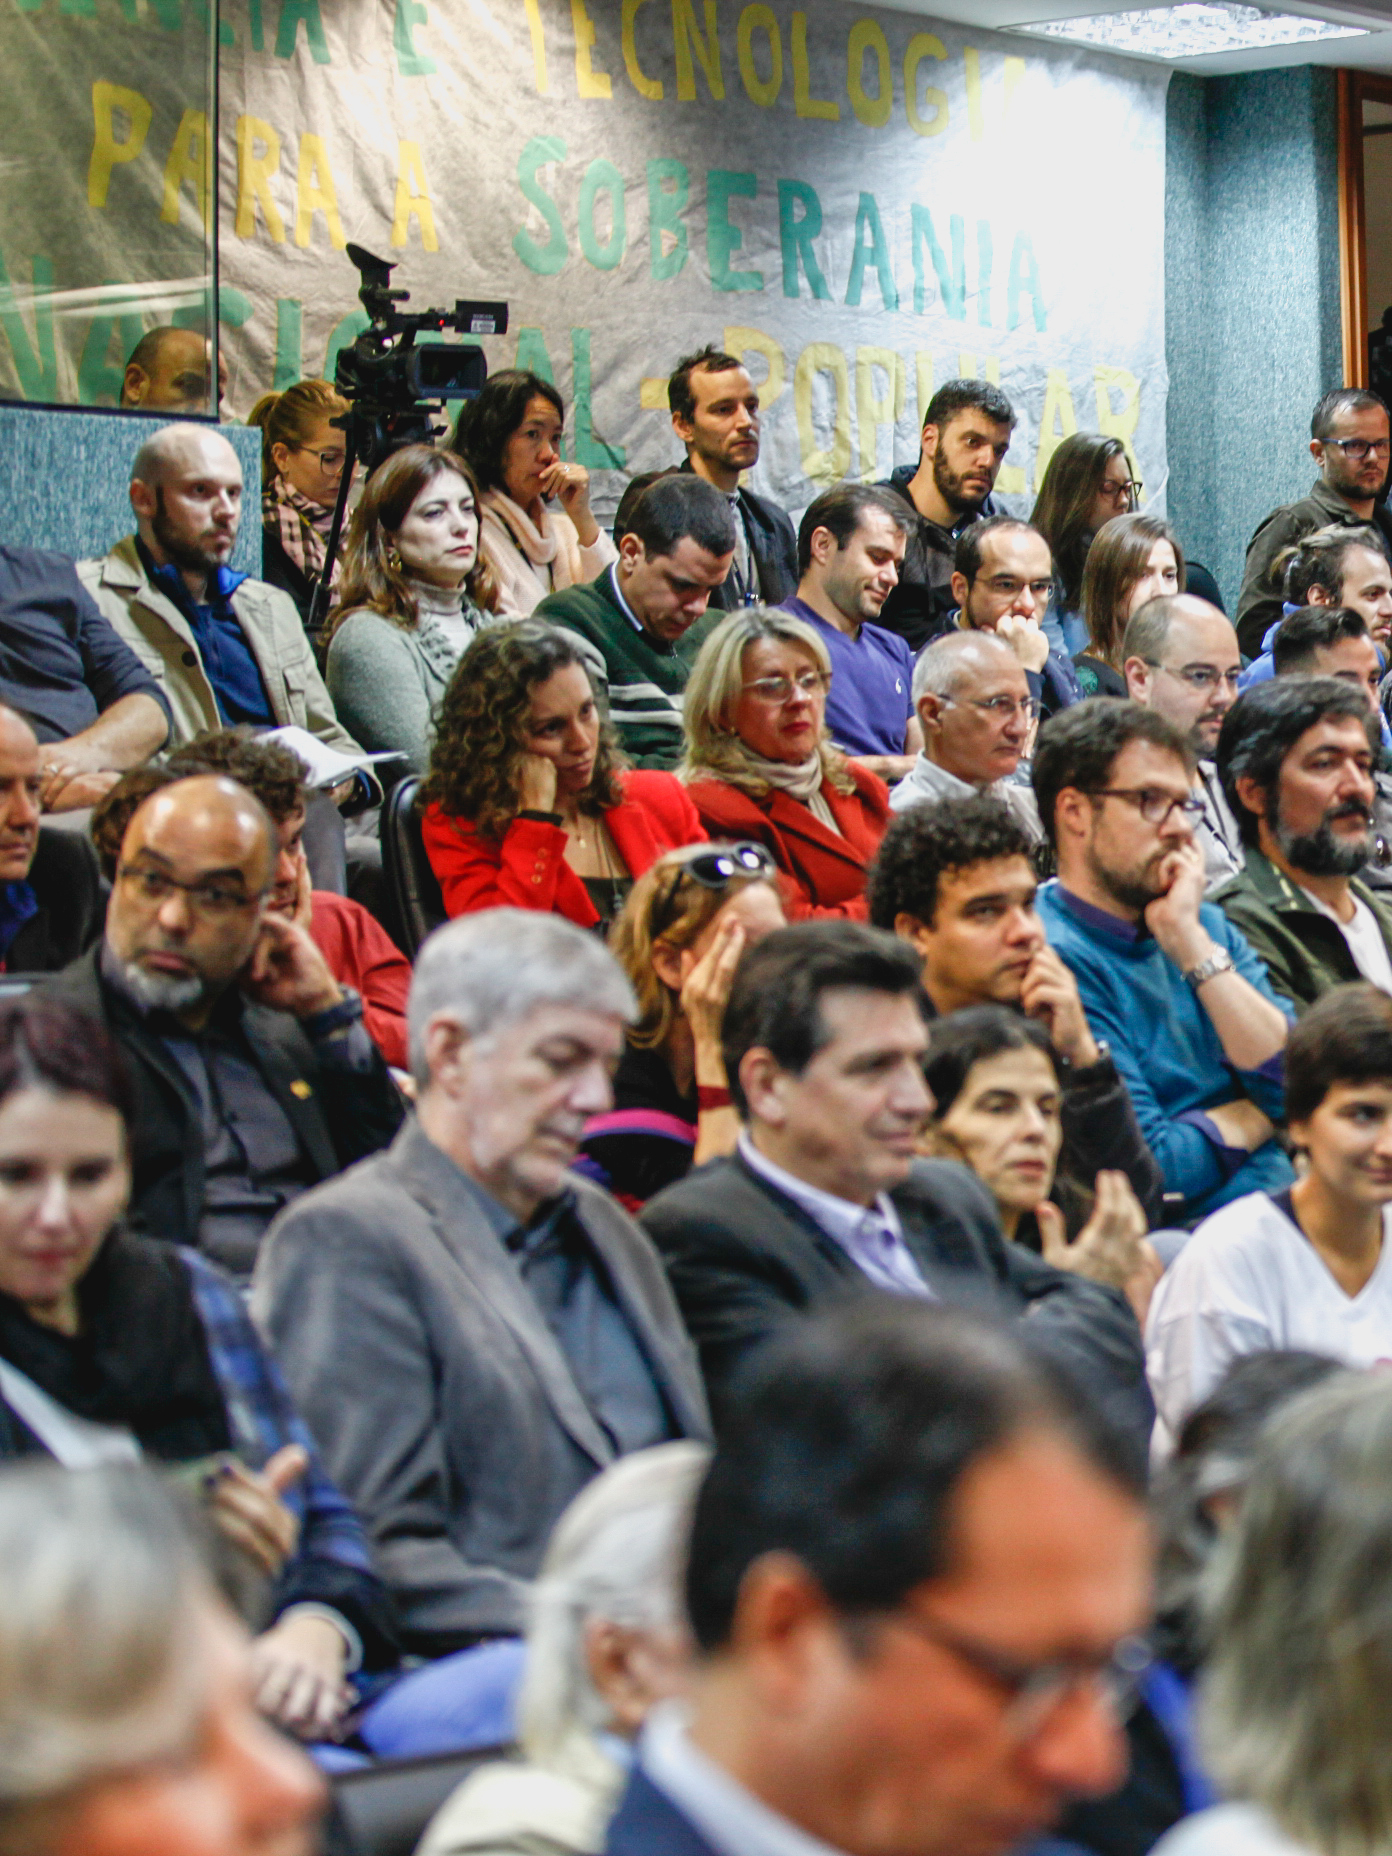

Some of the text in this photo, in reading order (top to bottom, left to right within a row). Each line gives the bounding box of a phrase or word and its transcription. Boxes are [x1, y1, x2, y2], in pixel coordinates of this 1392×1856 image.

[87, 80, 1048, 333] PARA A SOBERANIA
[0, 253, 627, 470] NAIL
